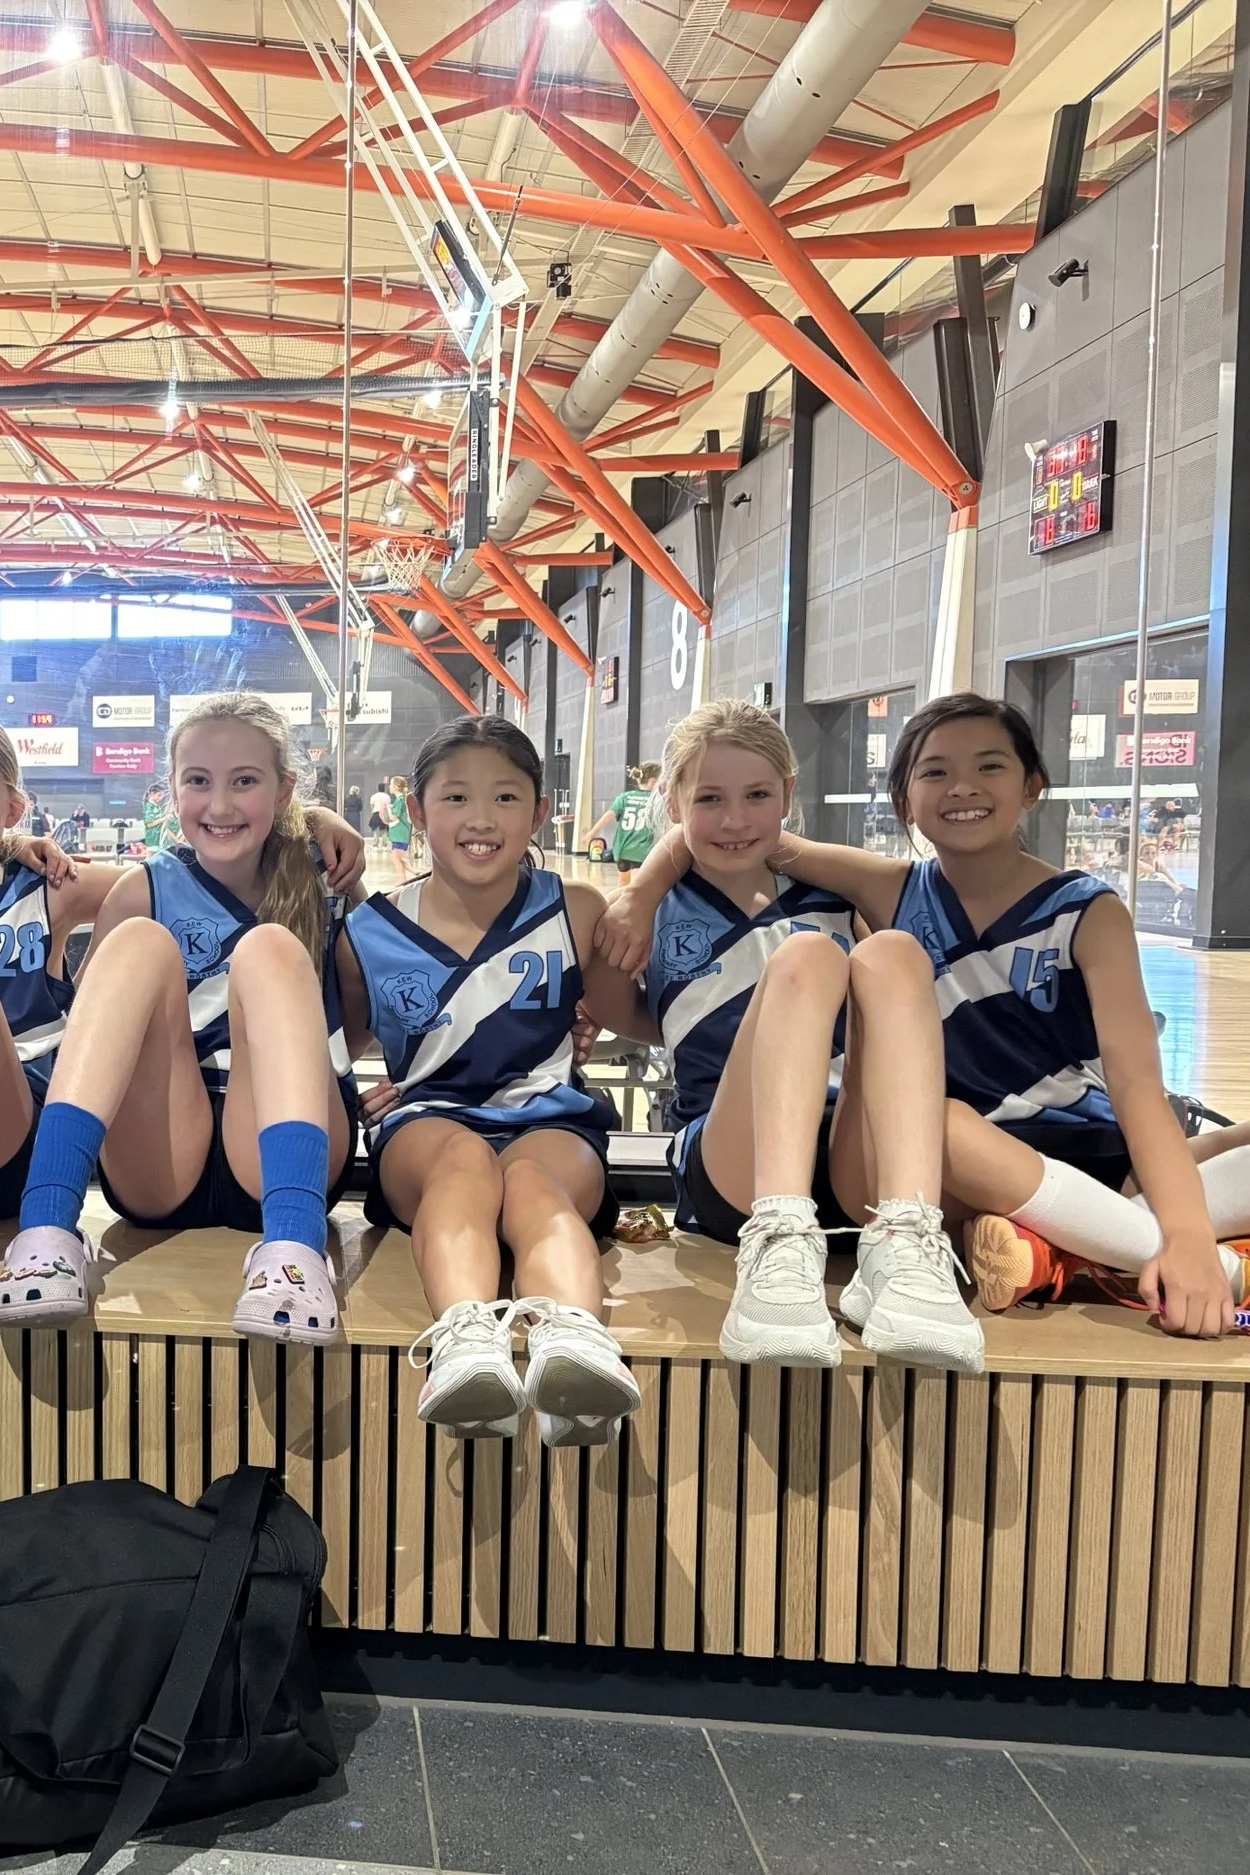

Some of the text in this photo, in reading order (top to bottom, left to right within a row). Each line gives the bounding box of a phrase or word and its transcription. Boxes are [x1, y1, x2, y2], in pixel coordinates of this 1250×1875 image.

[1150, 692, 1172, 701] MOTOR
[114, 706, 152, 715] MOTOR GROUP
[17, 739, 64, 756] Westfield
[105, 747, 133, 756] Bendigo
[133, 747, 151, 755] Bank
[183, 931, 209, 956] K
[672, 933, 699, 957] K
[397, 976, 413, 985] KEW
[508, 950, 563, 1011] 21
[1009, 946, 1060, 1013] 15
[396, 985, 425, 1014] K
